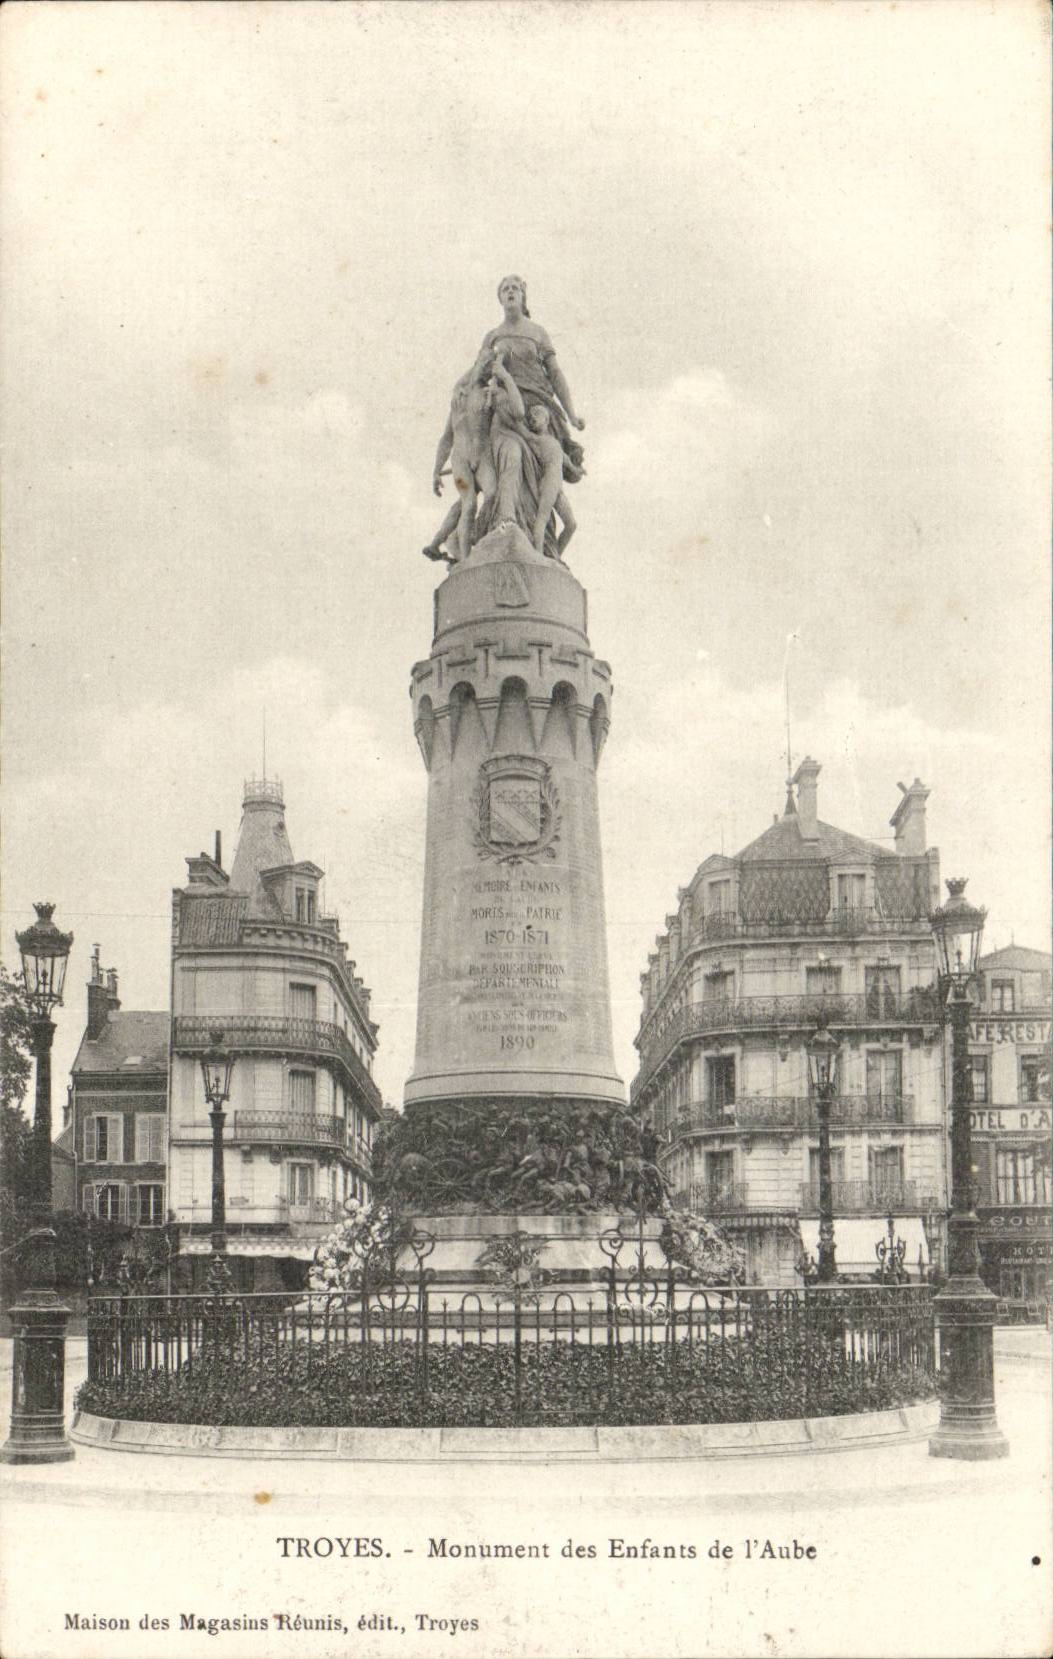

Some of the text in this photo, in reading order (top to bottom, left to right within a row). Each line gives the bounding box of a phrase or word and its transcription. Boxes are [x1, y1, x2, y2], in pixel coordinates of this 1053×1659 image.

[471, 905, 504, 920] MORTS
[526, 905, 562, 920] PATRIE
[484, 929, 550, 945] 1870-1871
[501, 1035, 536, 1050] 1890
